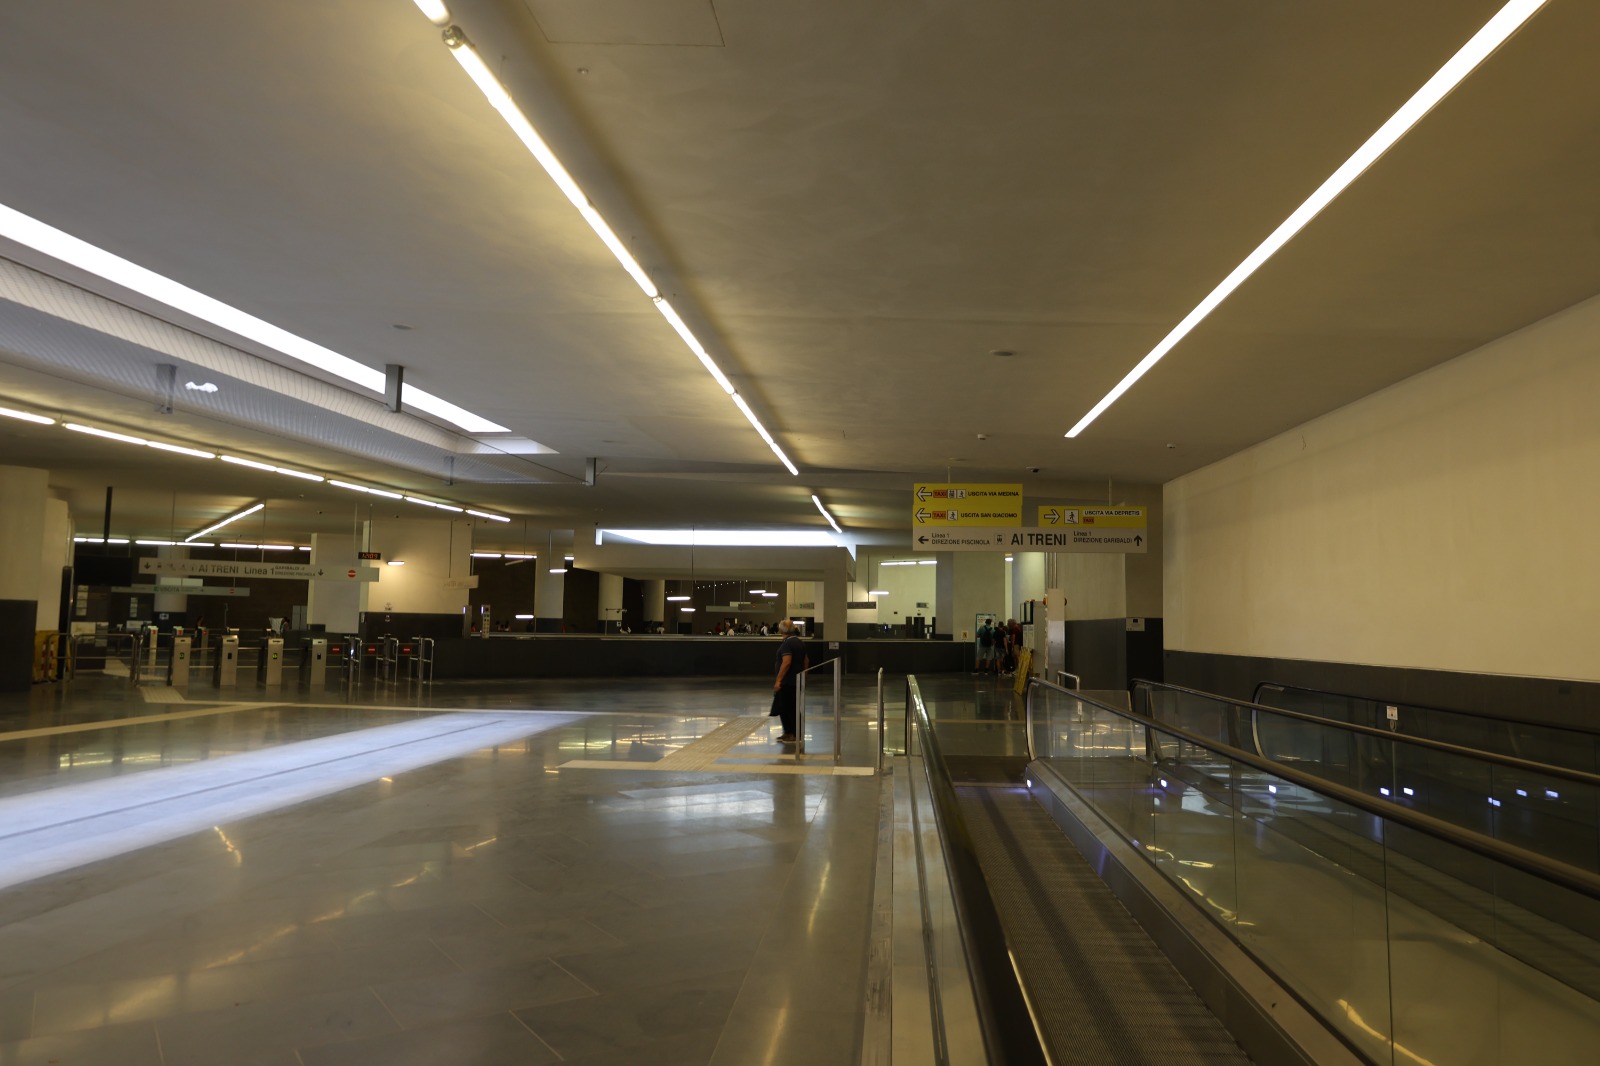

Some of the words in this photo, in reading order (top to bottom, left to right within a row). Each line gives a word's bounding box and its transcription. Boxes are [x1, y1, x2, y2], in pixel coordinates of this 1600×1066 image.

[1011, 533, 1024, 545] AI
[1027, 533, 1067, 546] TRENI
[198, 564, 208, 572] AI
[211, 565, 239, 574] TRENI
[244, 566, 268, 575] Linea
[270, 567, 275, 575] 1
